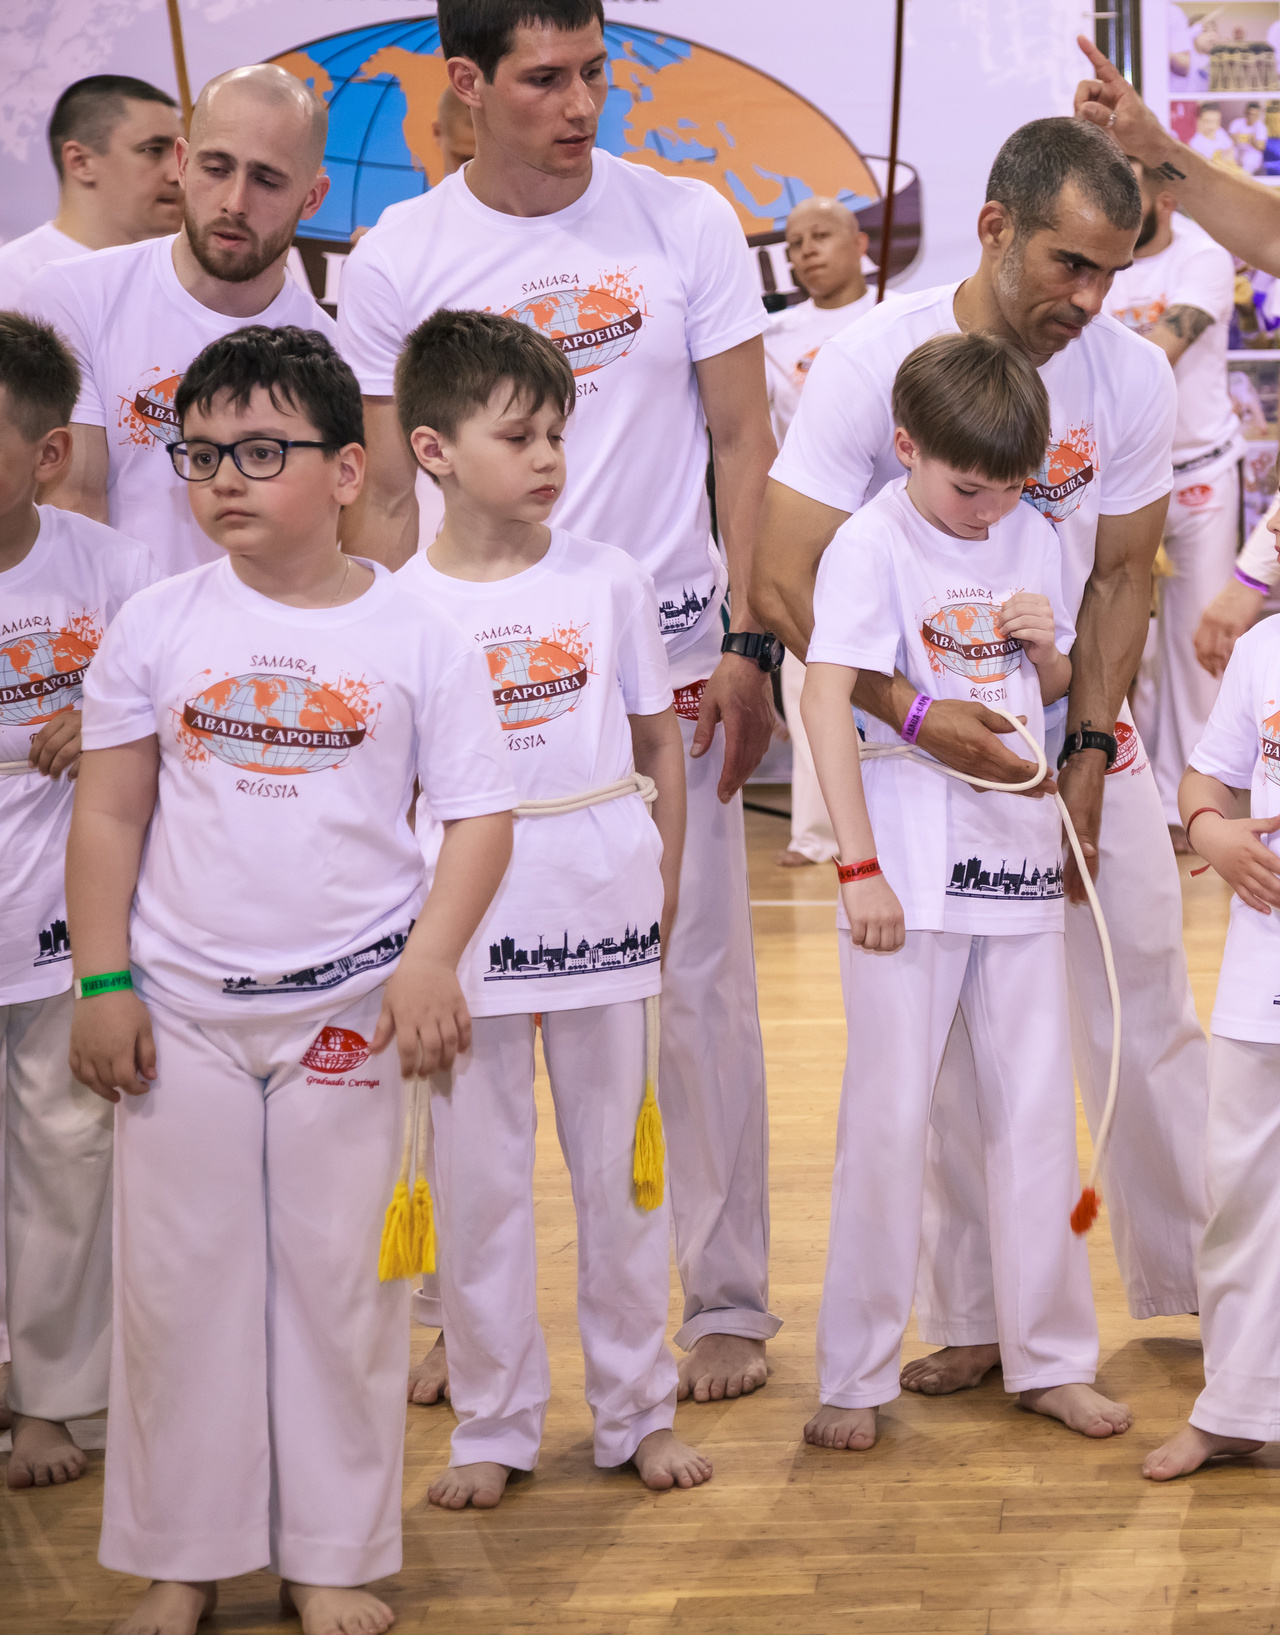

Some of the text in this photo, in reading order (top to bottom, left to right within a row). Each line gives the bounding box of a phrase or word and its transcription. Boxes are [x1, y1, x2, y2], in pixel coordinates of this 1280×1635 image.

[522, 273, 580, 295] SAMARA
[552, 321, 635, 351] CAPOEIRA
[575, 381, 598, 398] SIA
[1033, 475, 1085, 499] APOEIRA
[946, 588, 993, 600] SAMARA
[0, 615, 52, 637] AMARA
[474, 624, 533, 642] SAMARA
[250, 655, 317, 675] SAMARA
[0, 670, 87, 702] DÁ-CAPOEI
[494, 676, 581, 702] -CAPOEIRA
[969, 687, 1008, 703] RÚSSI
[191, 714, 351, 746] ABADÁ-CAPOEIRA
[235, 778, 299, 798] RÚSSIA
